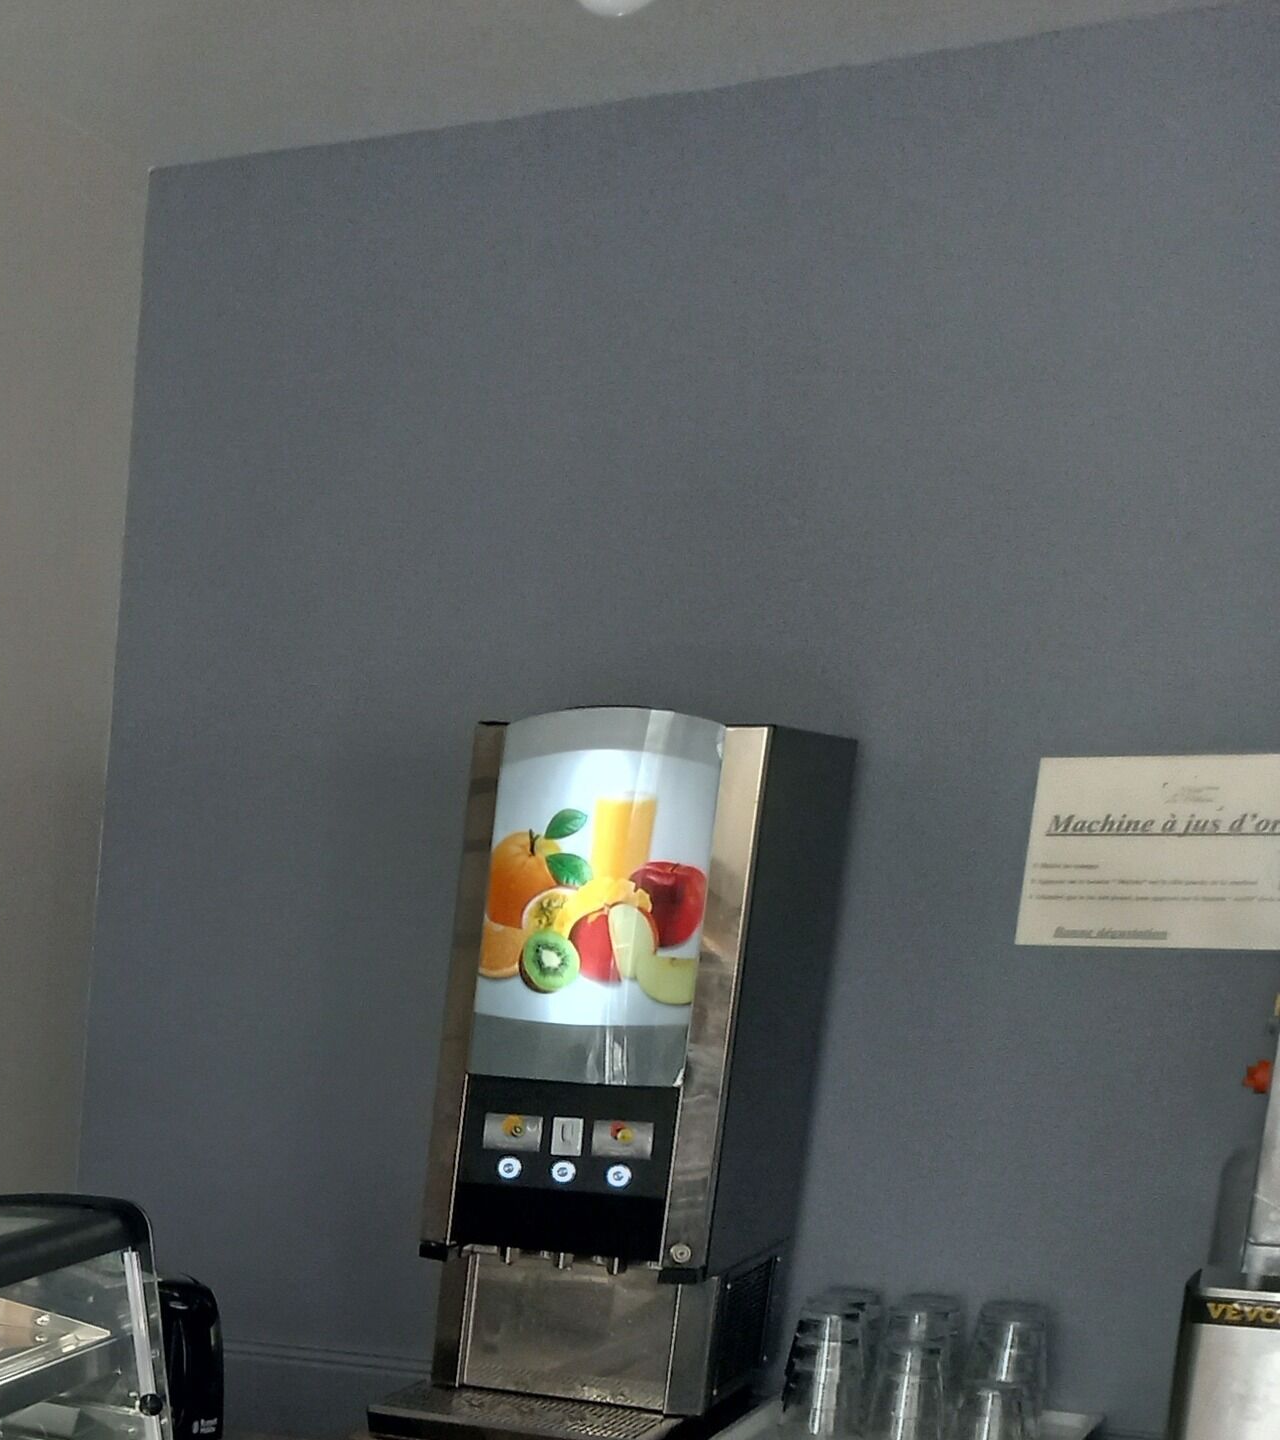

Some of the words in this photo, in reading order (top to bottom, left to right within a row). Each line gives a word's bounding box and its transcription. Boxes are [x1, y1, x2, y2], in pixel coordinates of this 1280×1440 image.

[1046, 813, 1155, 834] Machine
[1162, 813, 1176, 832] à
[1178, 814, 1222, 837] jus
[1206, 1303, 1280, 1324] VEVO
